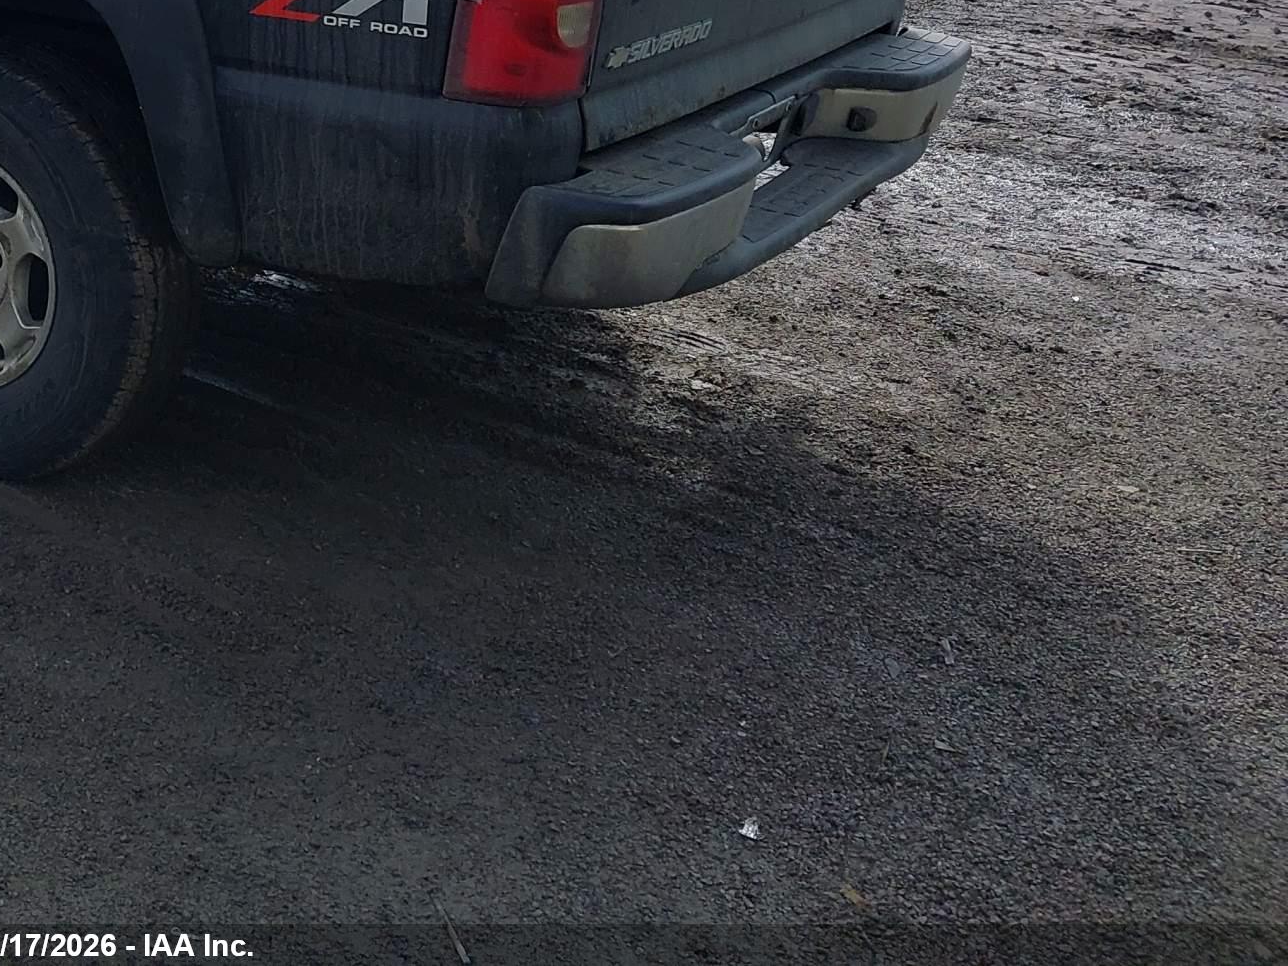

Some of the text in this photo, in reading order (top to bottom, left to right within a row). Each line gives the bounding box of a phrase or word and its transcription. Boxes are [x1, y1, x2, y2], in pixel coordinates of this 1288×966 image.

[323, 15, 429, 38] OFF ROAD
[627, 19, 713, 64] SILVERADO
